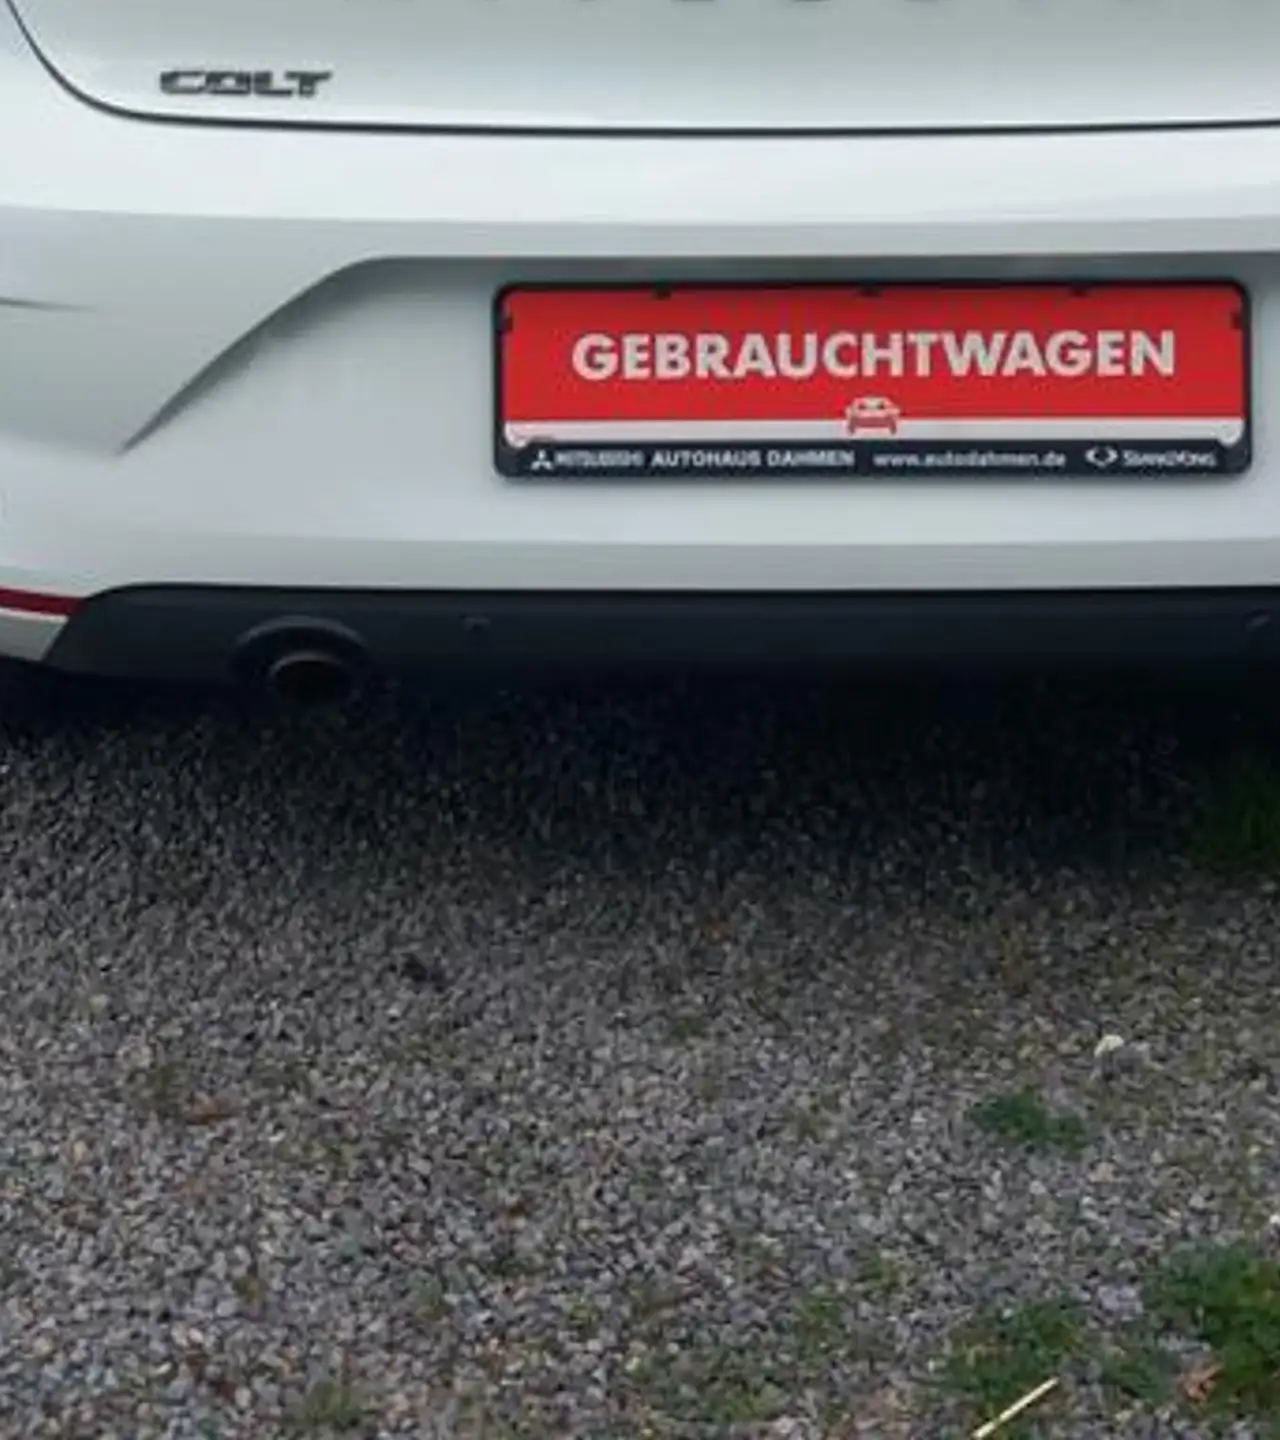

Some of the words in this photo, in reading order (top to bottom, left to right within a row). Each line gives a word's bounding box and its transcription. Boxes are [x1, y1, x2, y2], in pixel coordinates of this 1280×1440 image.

[159, 70, 332, 97] COLT
[571, 329, 1175, 381] GEBRAUCHTWAGEN
[651, 449, 761, 467] AUTOHAUS
